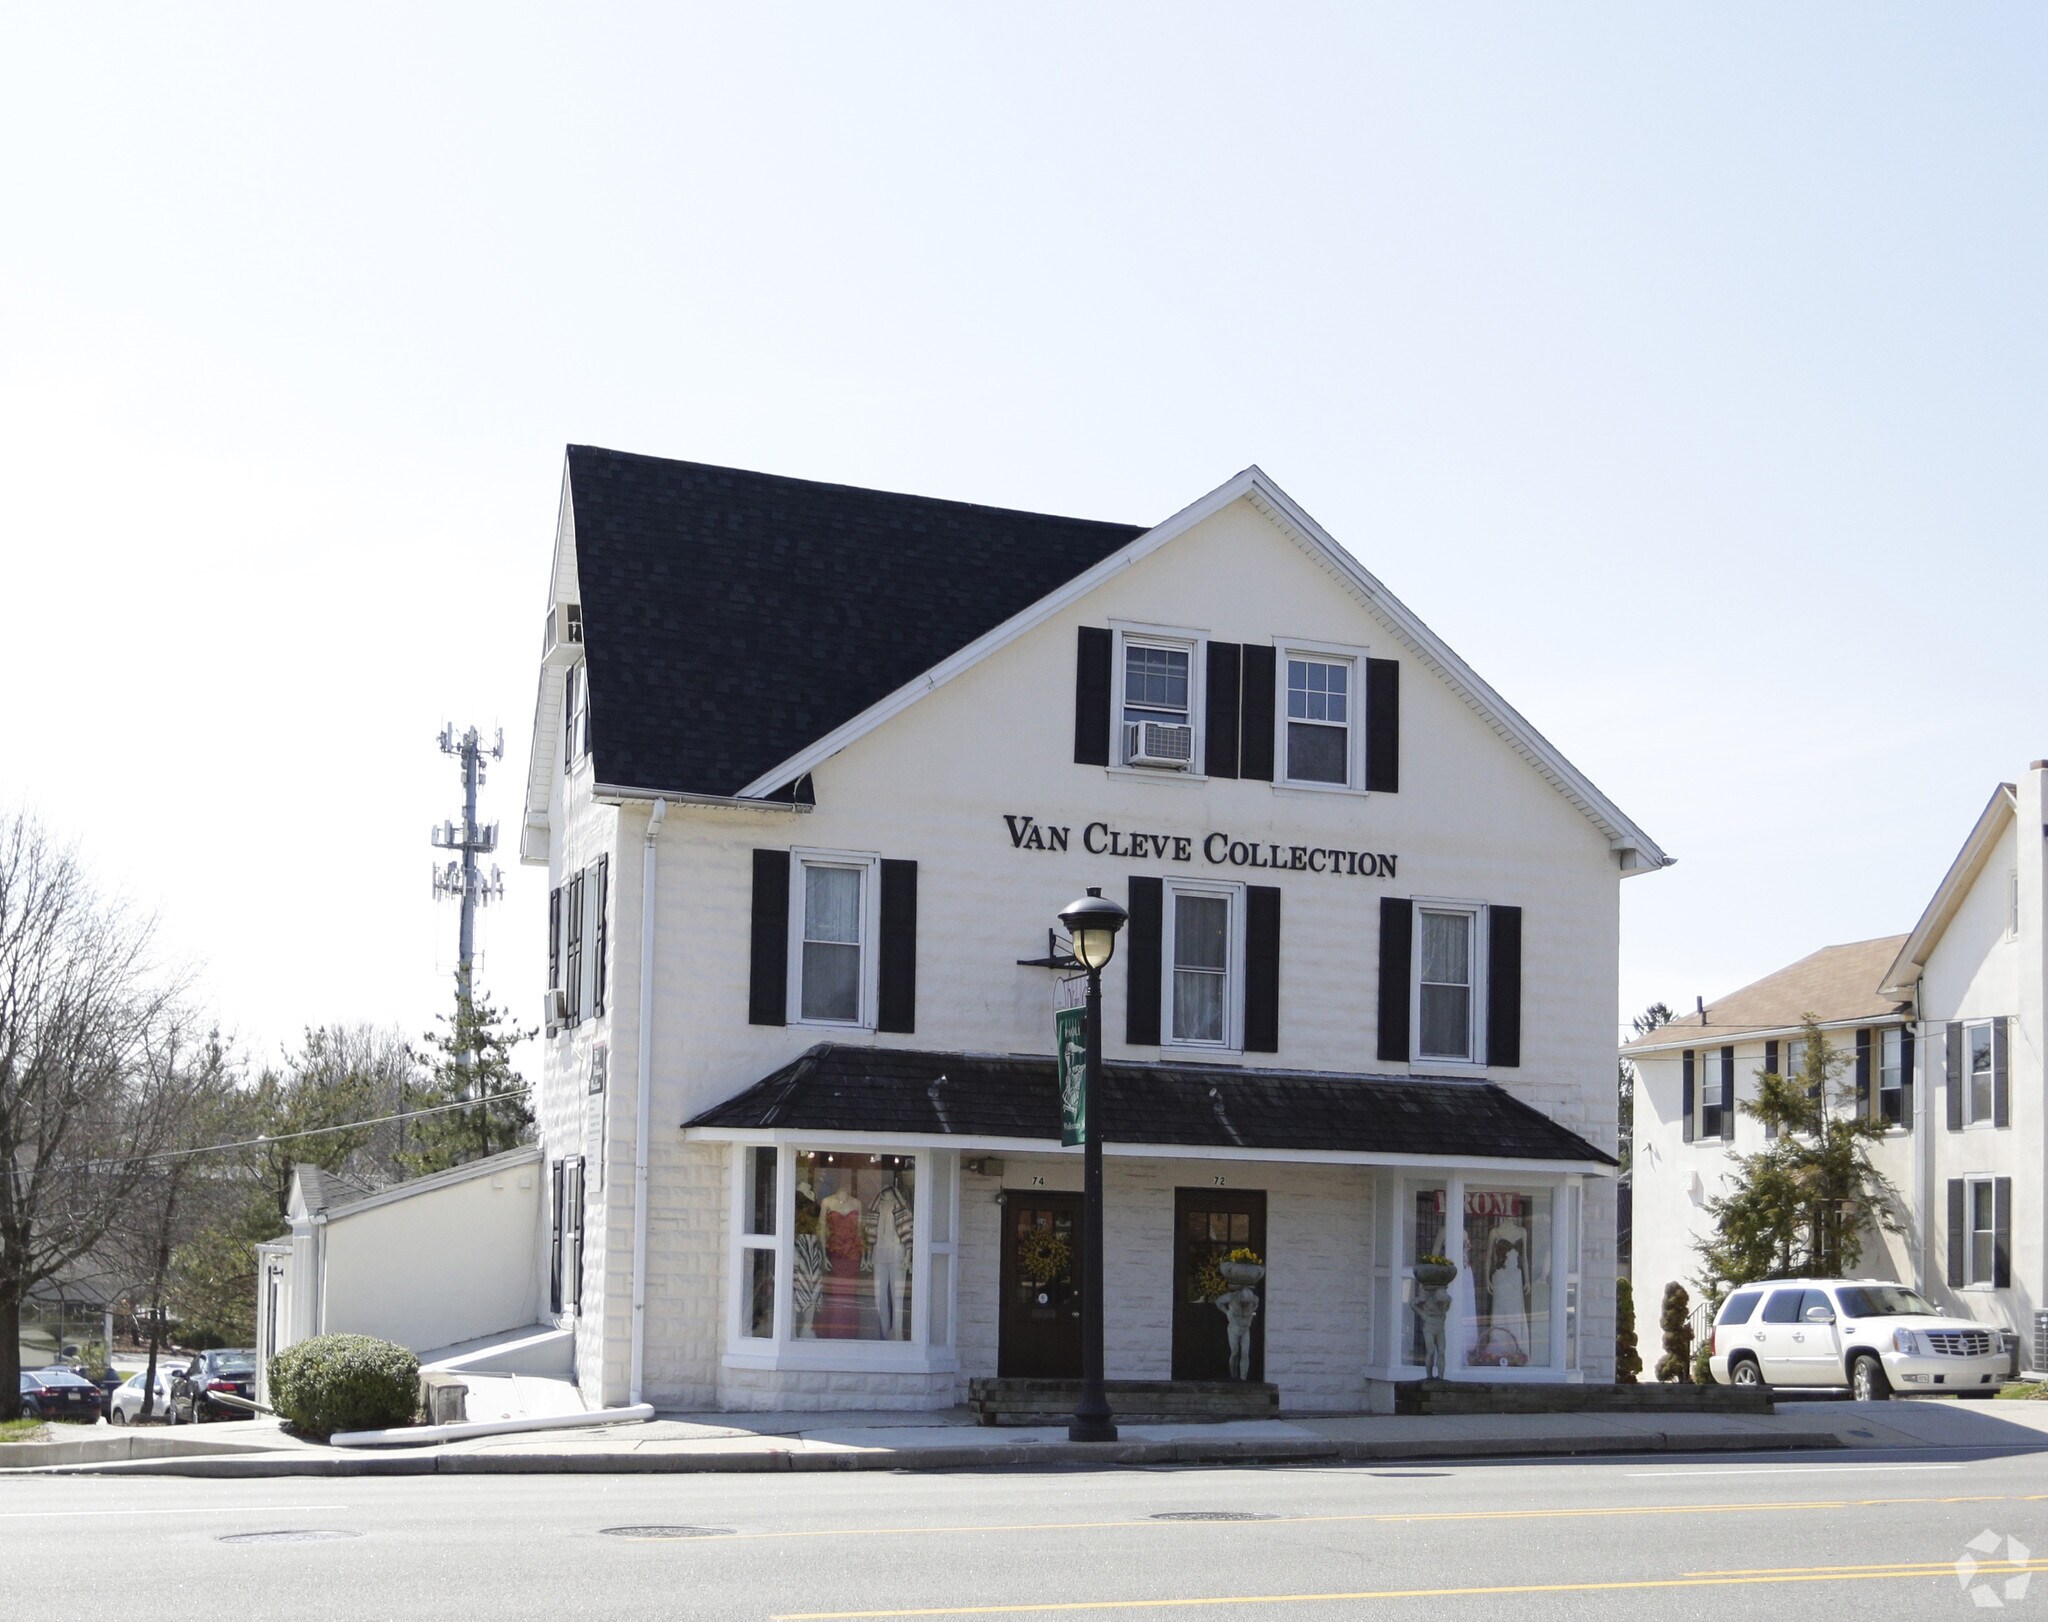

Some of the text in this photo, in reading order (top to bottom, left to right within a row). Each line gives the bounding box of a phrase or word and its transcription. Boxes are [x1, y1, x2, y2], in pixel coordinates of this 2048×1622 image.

[1003, 814, 1398, 878] VAN CLEVE COLLECTION
[1032, 1176, 1044, 1186] 74
[1214, 1175, 1225, 1186] 72
